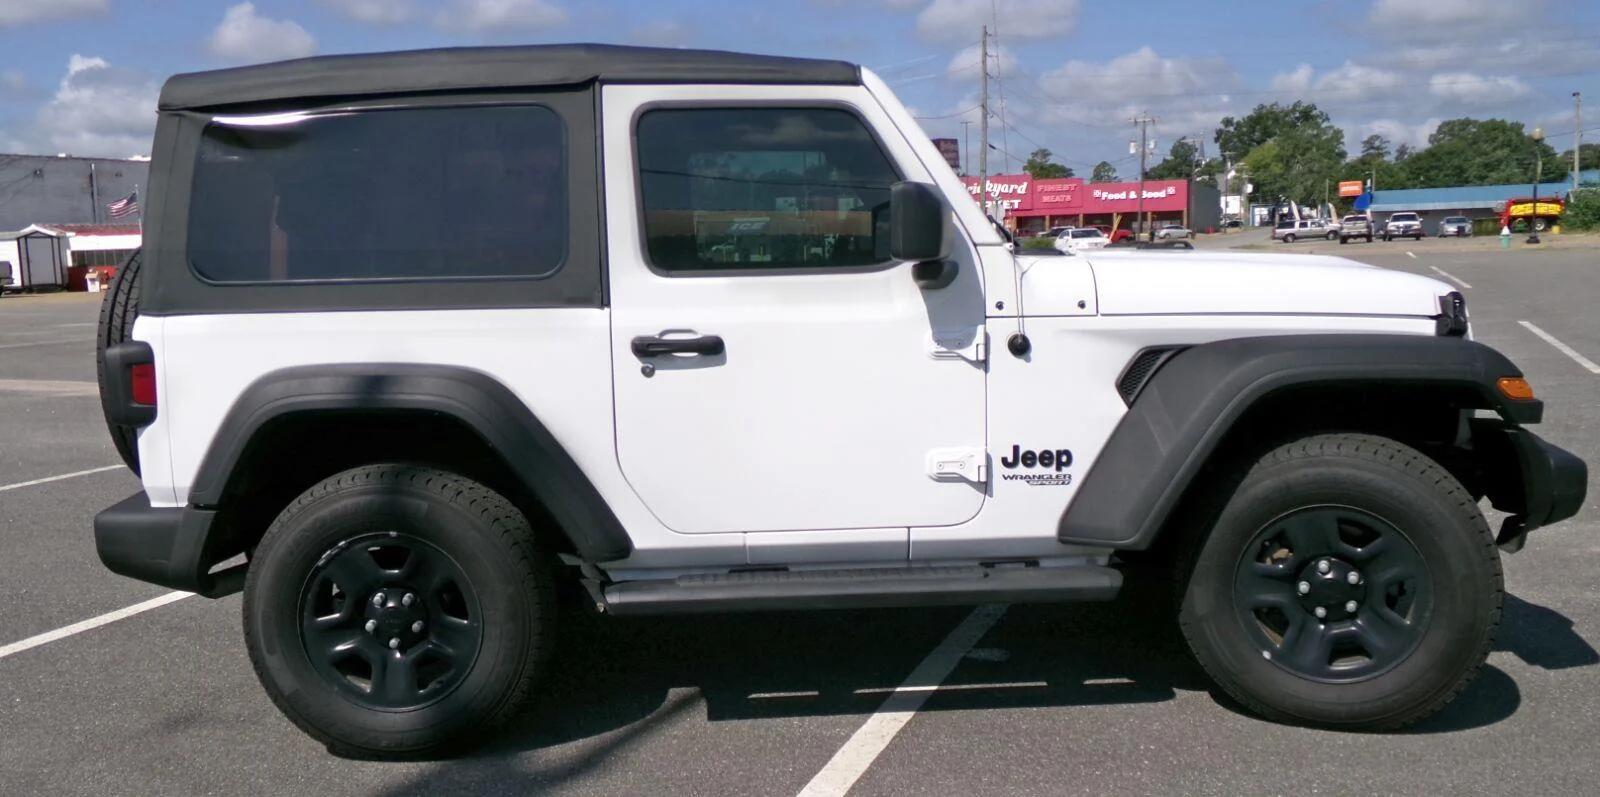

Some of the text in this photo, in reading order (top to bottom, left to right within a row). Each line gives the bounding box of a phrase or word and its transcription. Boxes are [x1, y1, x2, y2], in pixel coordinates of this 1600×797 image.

[1037, 183, 1077, 192] FINEST
[1042, 195, 1071, 203] MEATS
[1101, 190, 1127, 200] Feed
[1129, 190, 1137, 200] &
[1001, 444, 1073, 472] Jeep
